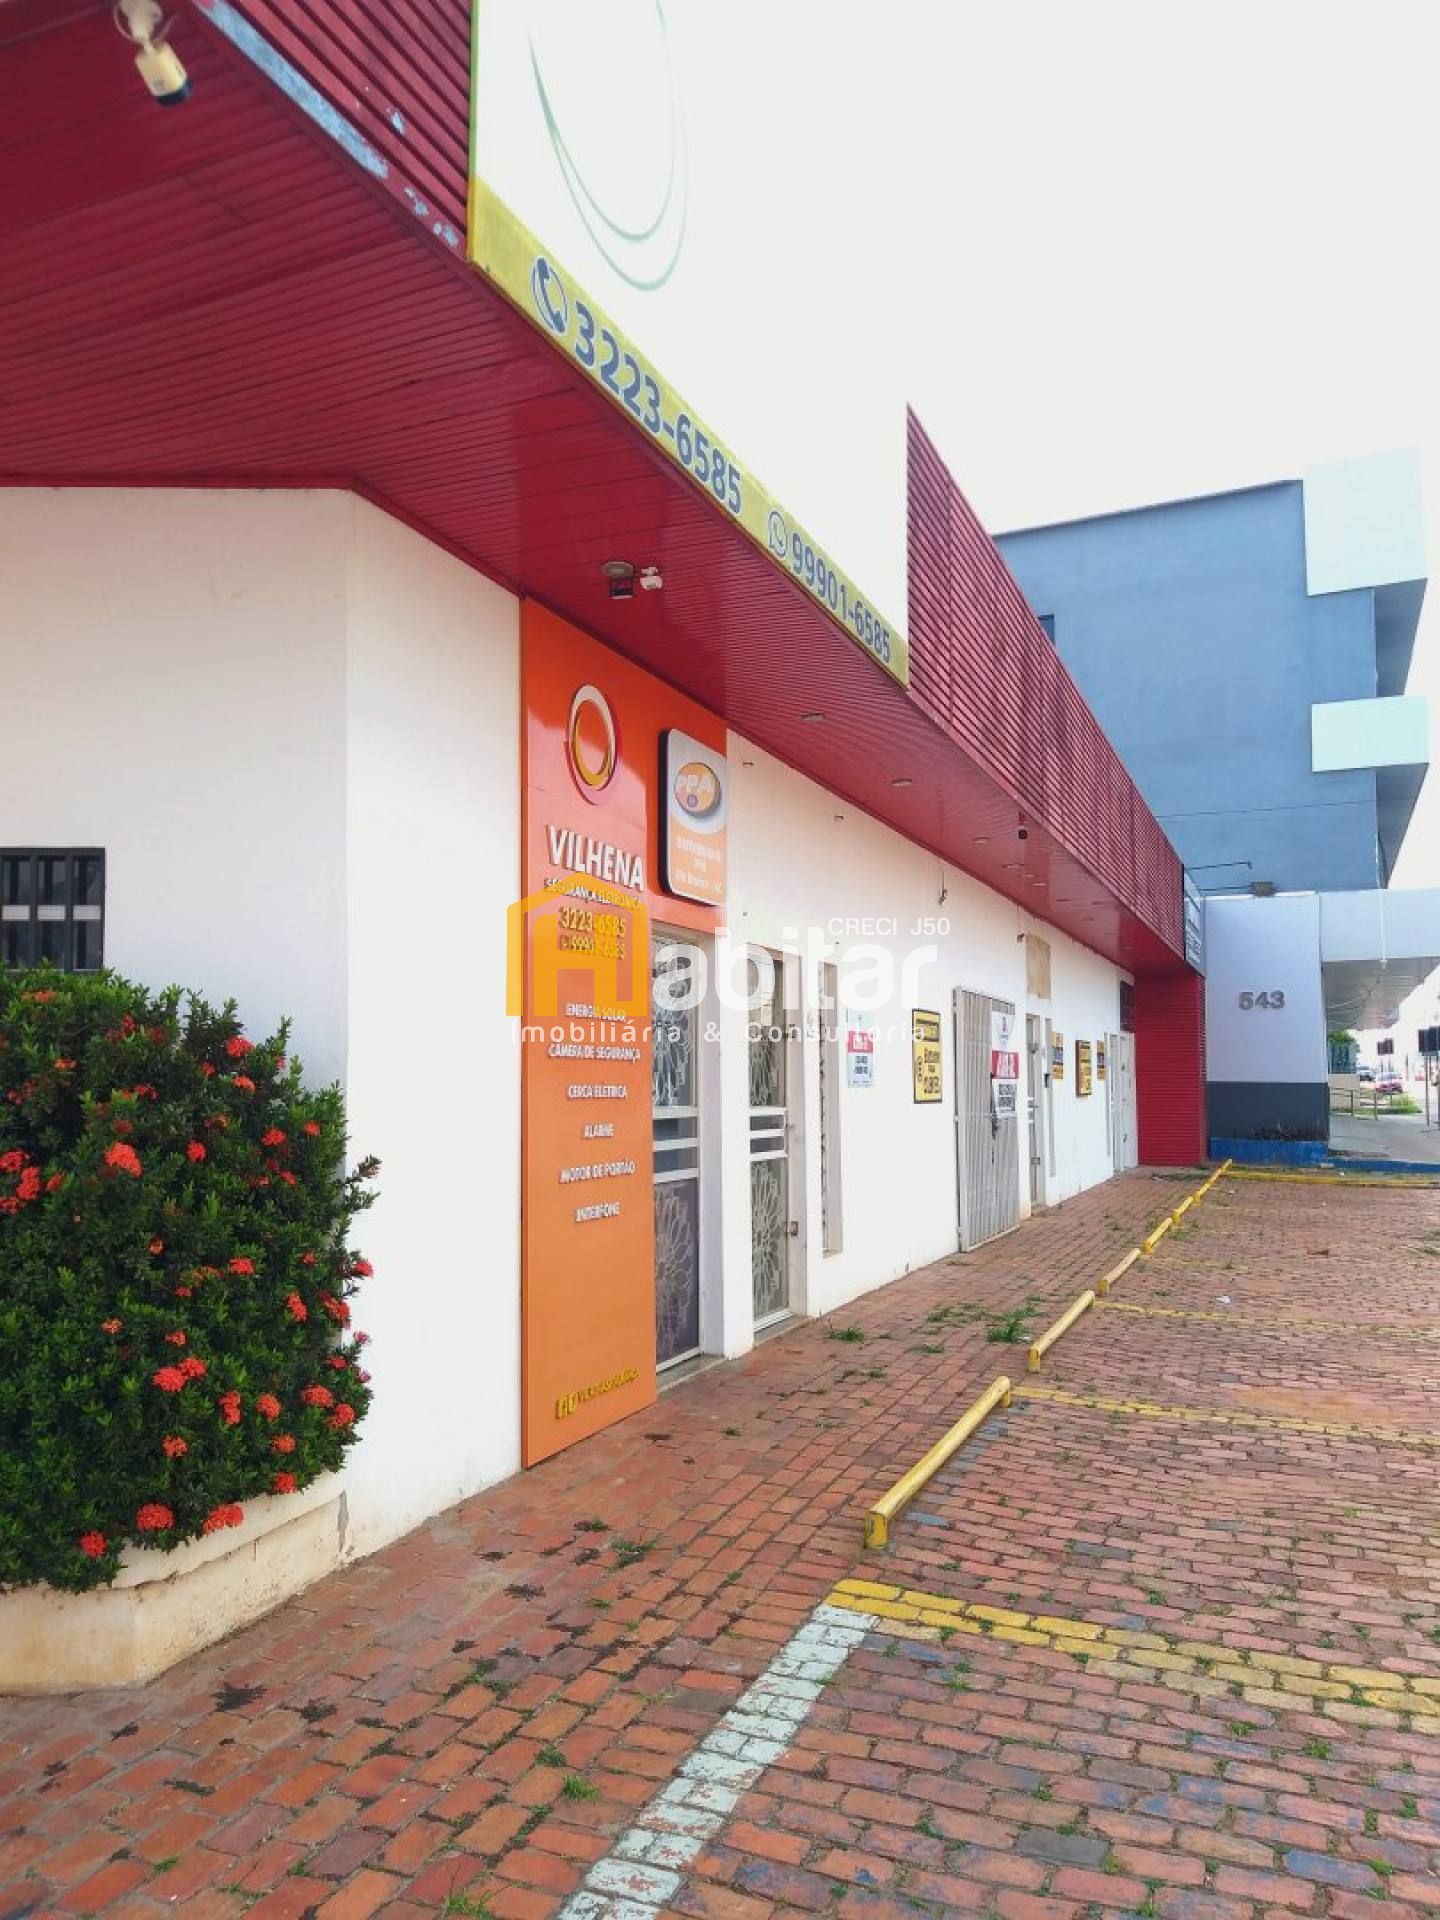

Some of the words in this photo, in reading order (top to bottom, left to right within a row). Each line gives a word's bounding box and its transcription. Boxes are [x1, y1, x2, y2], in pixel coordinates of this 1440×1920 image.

[574, 301, 742, 515] 3223-6585
[791, 532, 891, 664] 99901-6585
[546, 824, 645, 892] VILHENA
[1238, 990, 1286, 1010] 543
[592, 1163, 603, 1179] DE
